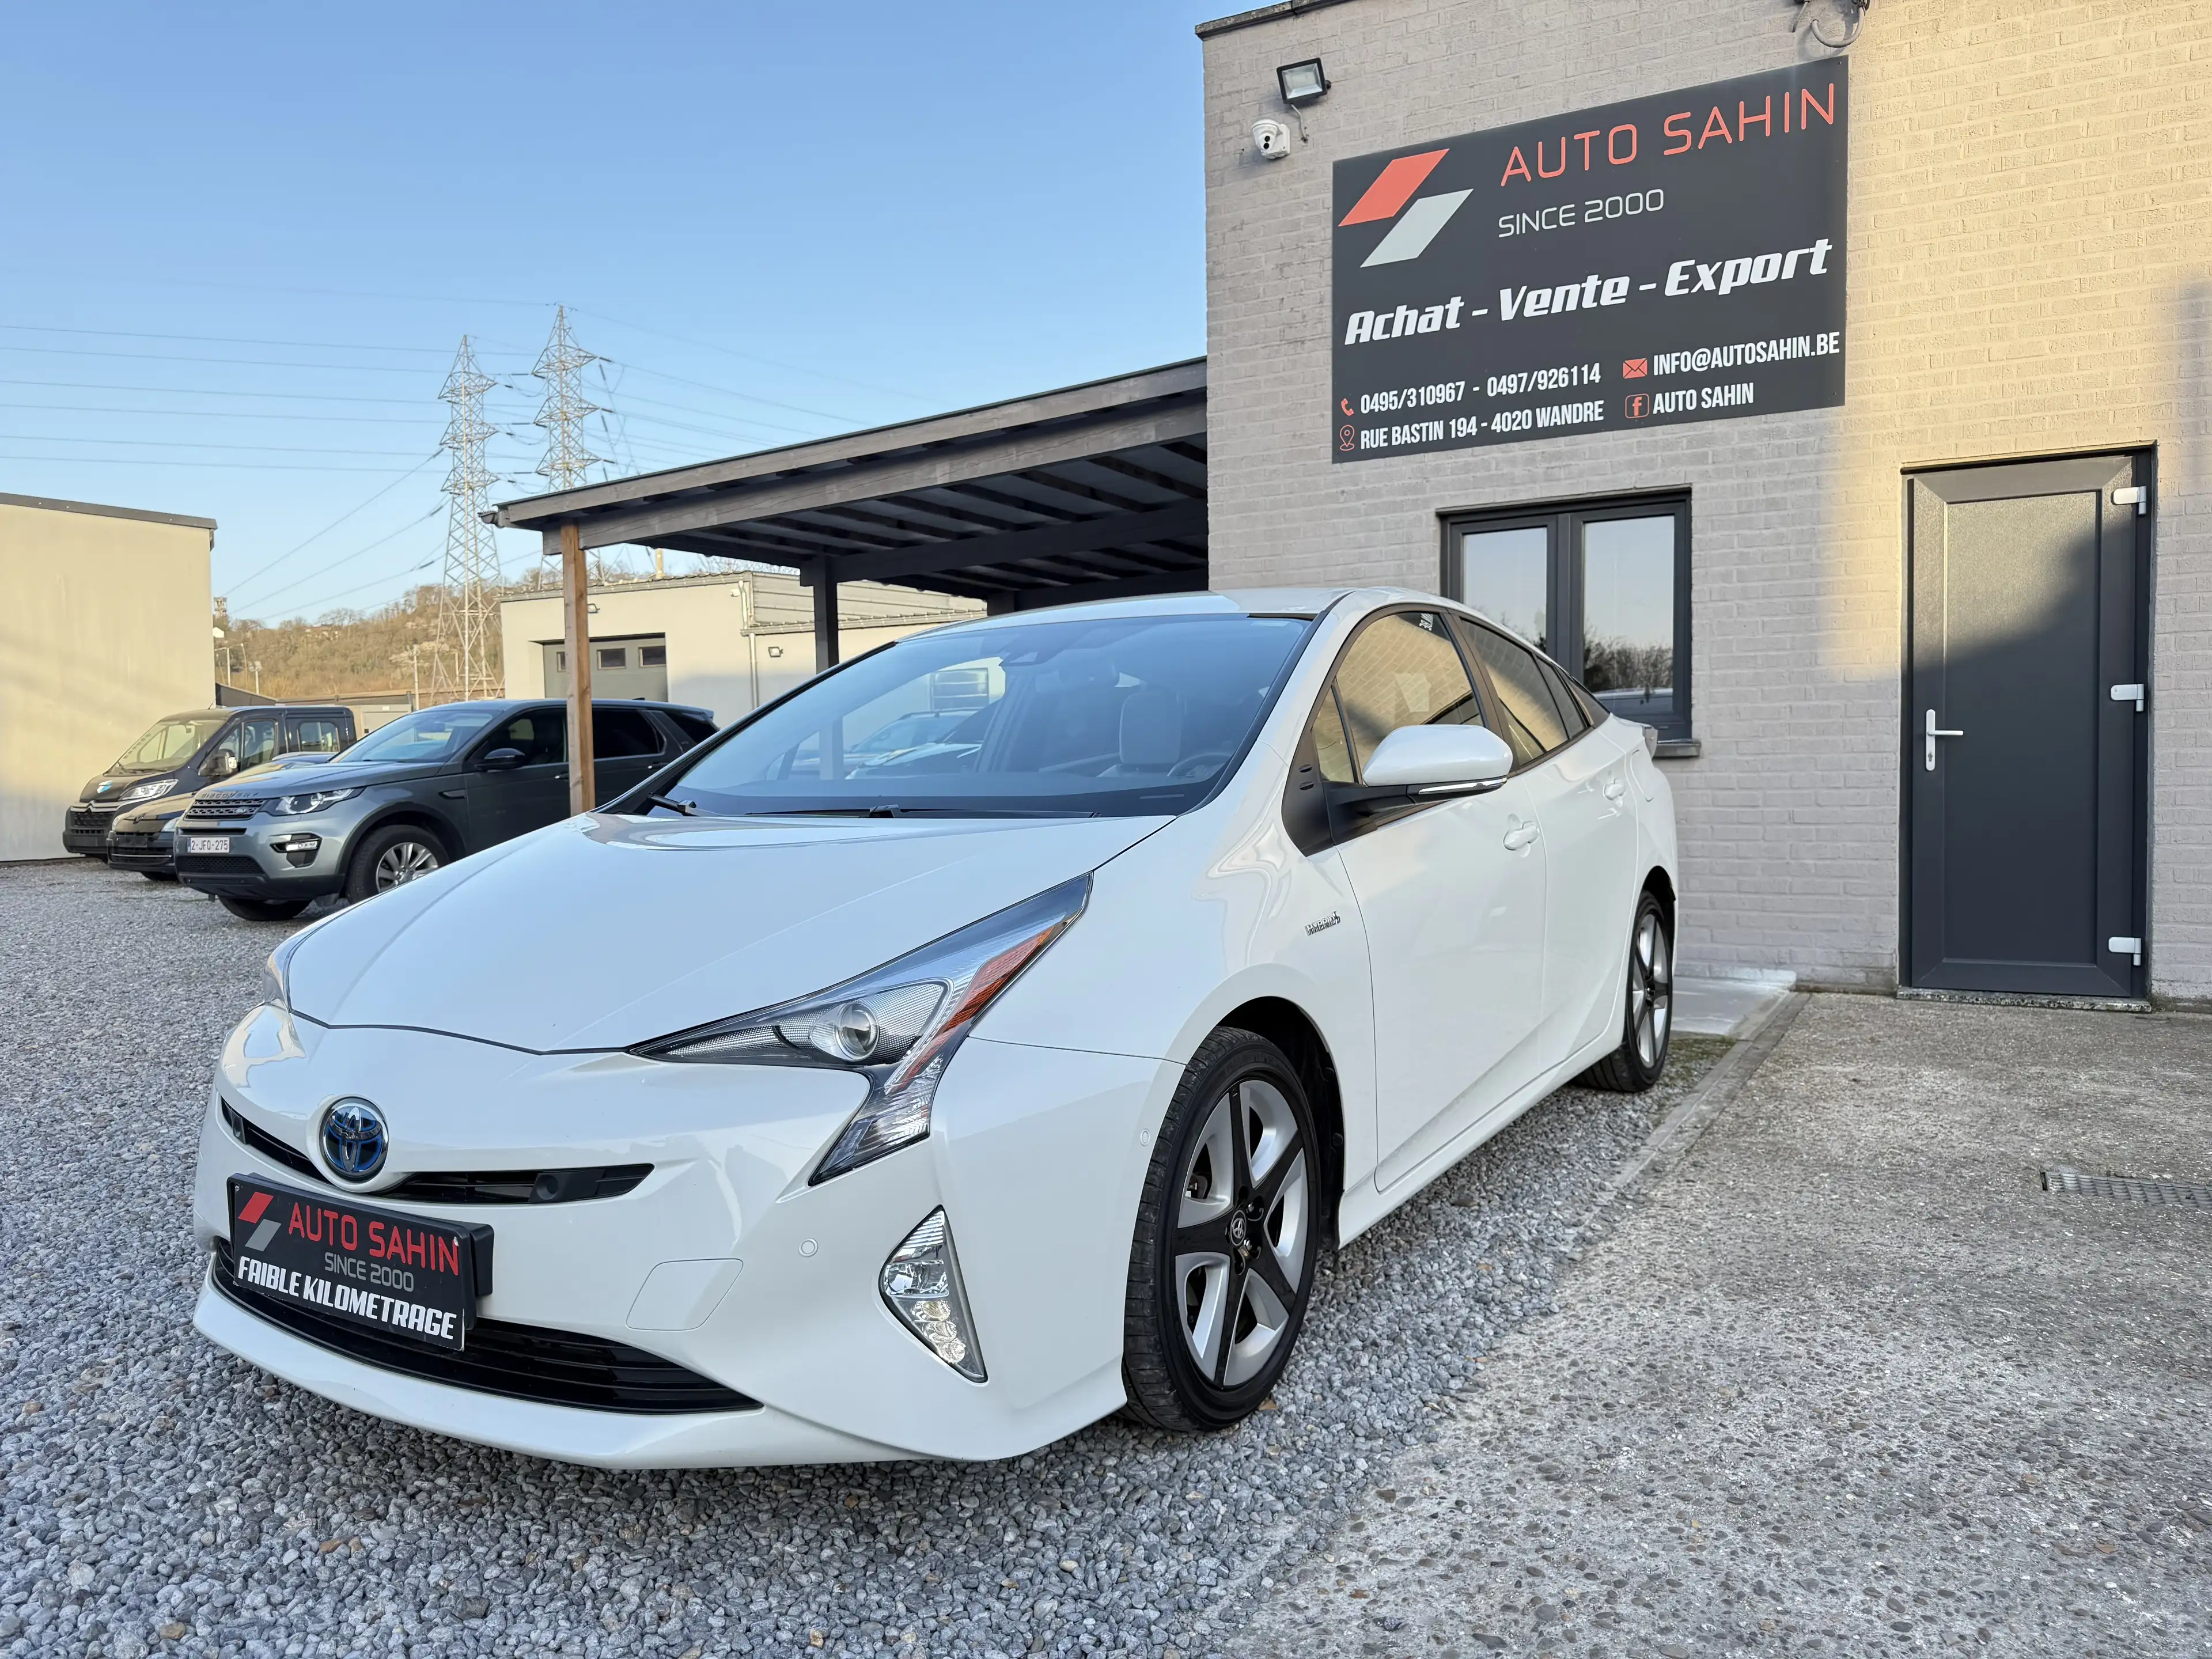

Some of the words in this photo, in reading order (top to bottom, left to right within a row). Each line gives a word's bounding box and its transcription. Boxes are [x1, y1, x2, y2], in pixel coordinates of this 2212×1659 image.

[1501, 124, 1637, 186] AUTO
[1664, 84, 1834, 155] SAHIN
[1499, 204, 1575, 237] SINCE
[1585, 189, 1663, 222] 2000
[1345, 297, 1464, 344] Achat
[1500, 275, 1630, 320] Vente
[1665, 239, 1832, 296] Export
[1654, 332, 1839, 375] INFO@AUTOSAHIN.BE
[1361, 381, 1465, 413] 0495/310967
[1487, 363, 1601, 396] 0497/926114
[1653, 391, 1696, 414] AUTO
[1702, 382, 1753, 408] SAHIN
[1361, 428, 1388, 449] RUE
[1392, 421, 1443, 445] BASTIN
[1449, 416, 1477, 438] 194
[1491, 410, 1532, 432] 4020
[1536, 400, 1604, 427] WANDRE
[289, 1202, 358, 1250] AUTO
[369, 1222, 459, 1275] SAHIN
[325, 1252, 366, 1280] SINCE
[370, 1263, 414, 1291] 2000
[238, 1256, 301, 1297] FAIBLE
[303, 1278, 457, 1339] KILOMETRAGE
